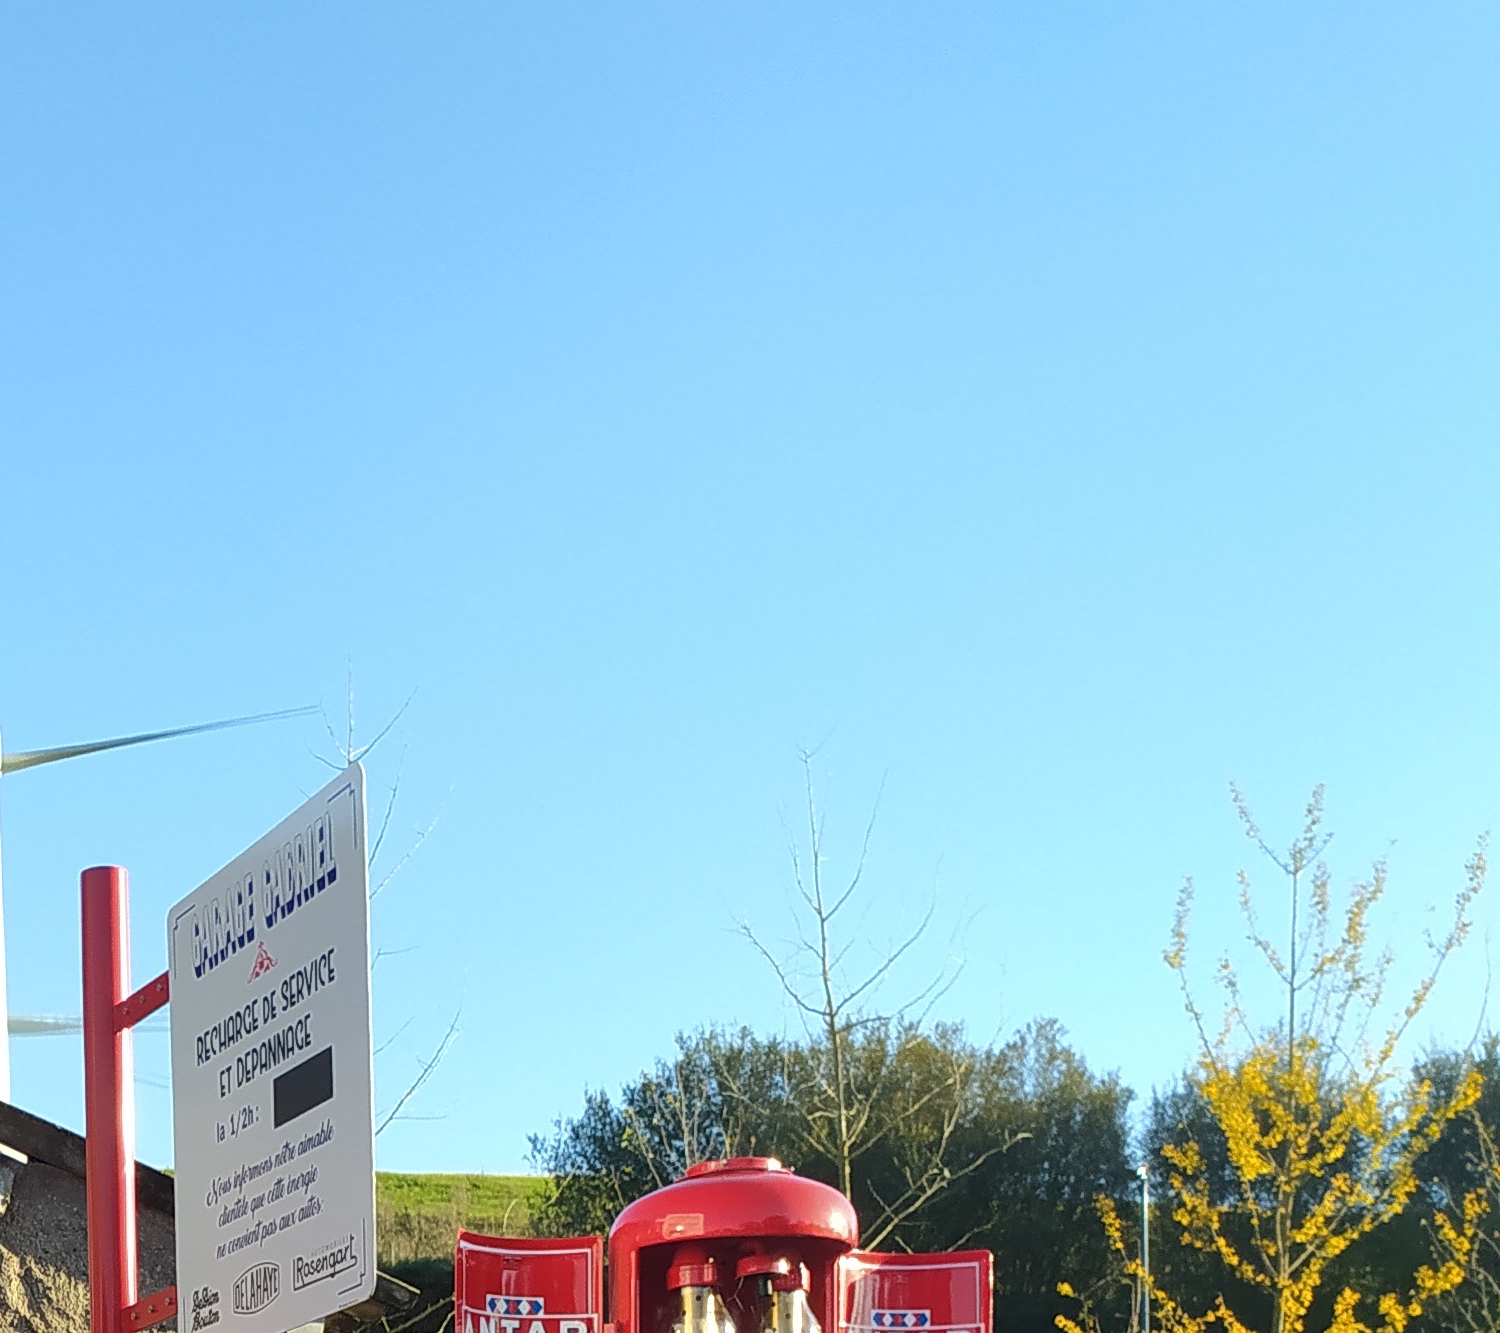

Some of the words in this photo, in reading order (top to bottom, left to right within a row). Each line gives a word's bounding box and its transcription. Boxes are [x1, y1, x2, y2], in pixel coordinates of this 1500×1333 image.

[191, 871, 255, 980] GARAGE
[195, 999, 259, 1066] RECHARGE
[263, 990, 277, 1025] DE
[281, 948, 335, 1011] SERVICE
[219, 1066, 232, 1098] ET
[237, 1013, 311, 1088] DEPANNAGE
[206, 1177, 232, 1207] Nous
[298, 1118, 334, 1156] aimable
[216, 1122, 225, 1143] la
[251, 1192, 266, 1220] que
[267, 1177, 286, 1205] cette
[216, 1243, 227, 1259] ne
[228, 1219, 263, 1255] convient
[260, 1218, 278, 1247] pas
[279, 1209, 297, 1232] aux
[234, 1266, 278, 1311] DELAHAYE
